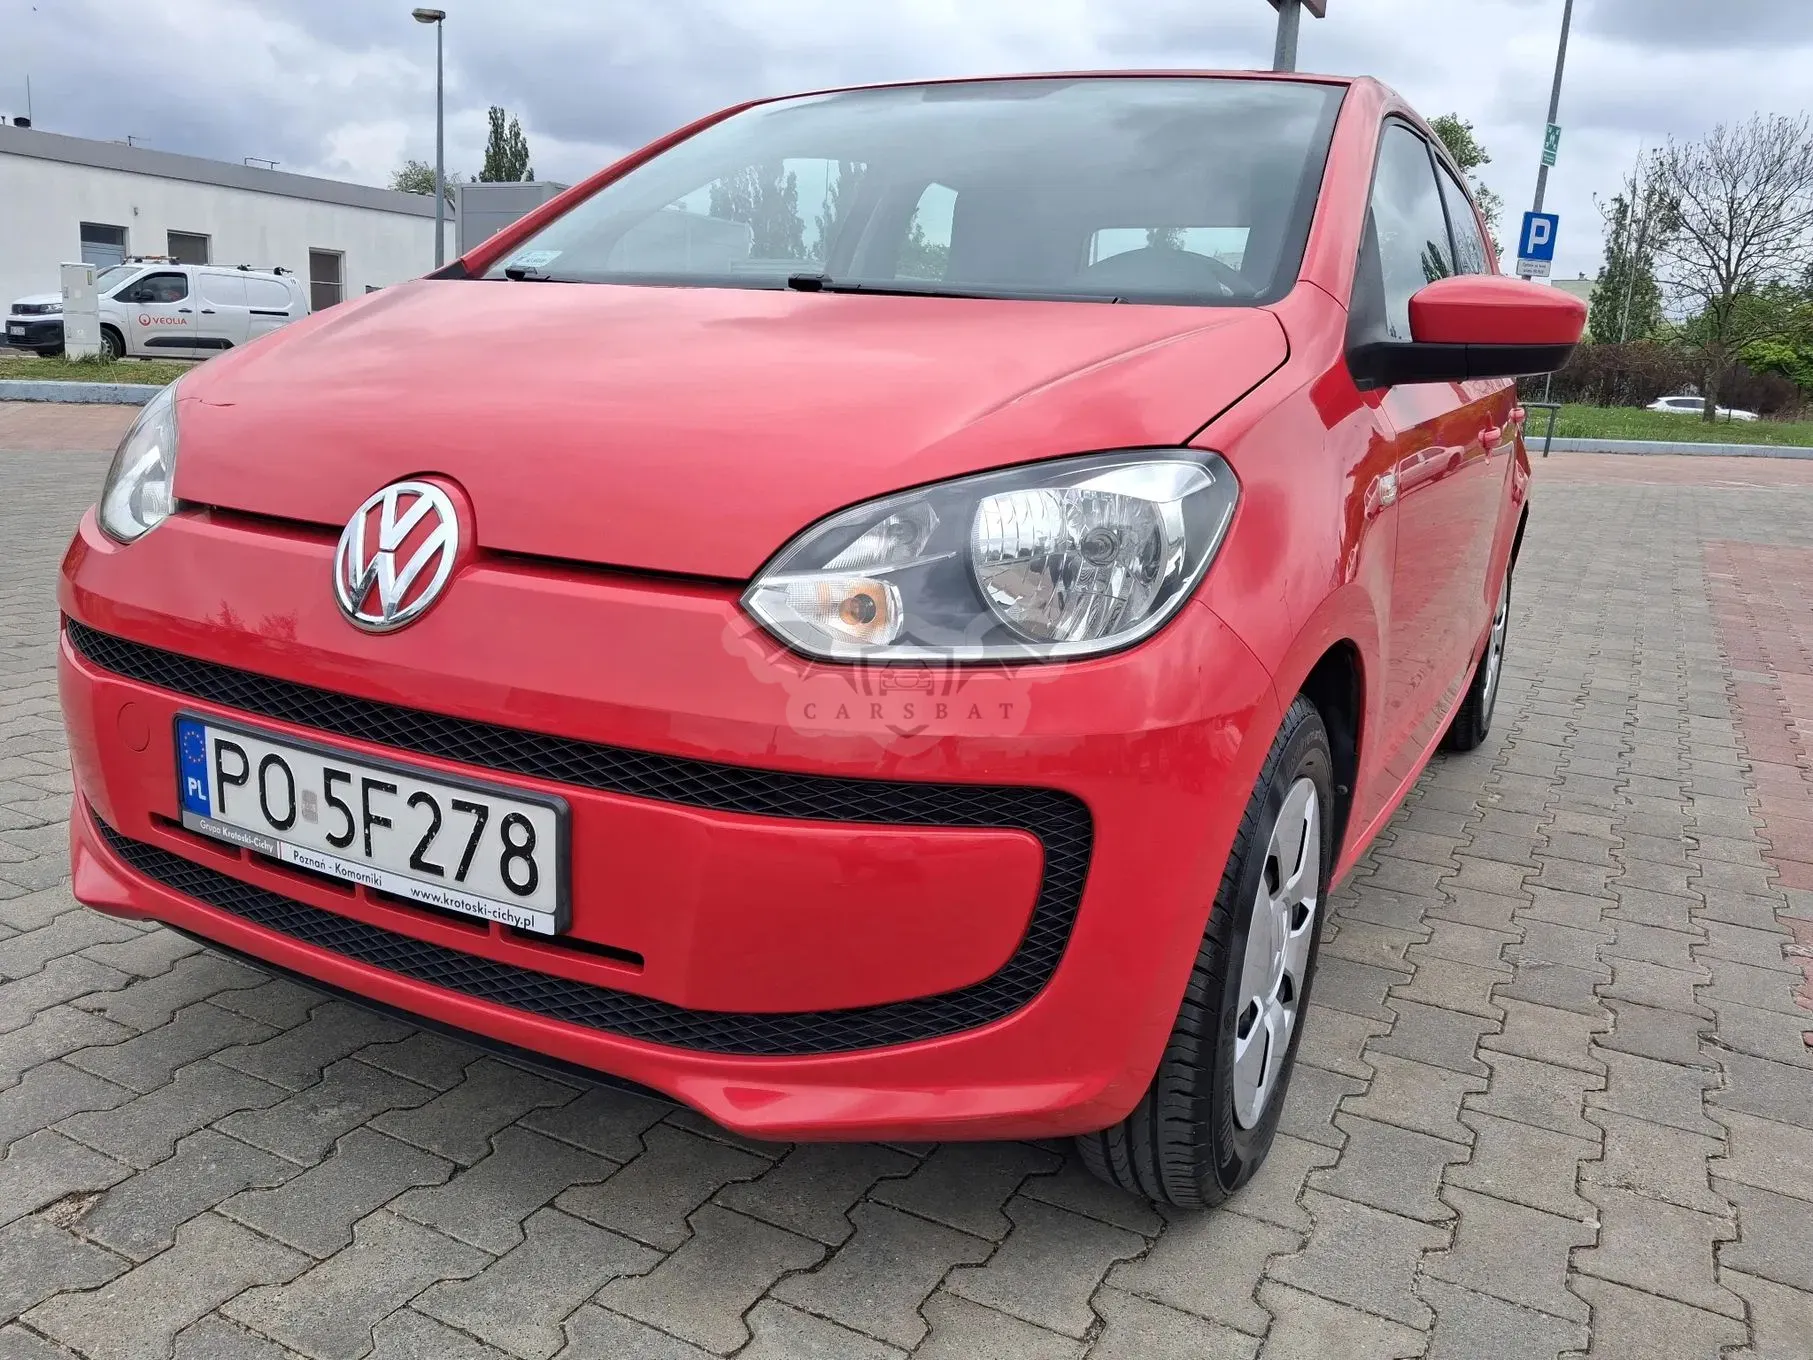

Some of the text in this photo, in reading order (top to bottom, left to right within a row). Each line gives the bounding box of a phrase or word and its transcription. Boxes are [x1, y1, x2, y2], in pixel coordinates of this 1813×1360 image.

[1526, 217, 1550, 254] P
[152, 317, 188, 325] VEOLIA
[187, 776, 207, 801] PL
[213, 738, 539, 897] PO 5F278
[222, 826, 274, 854] Krotoski-Cichy
[293, 850, 326, 870] Poznań
[335, 862, 382, 887] Komorniki
[410, 887, 535, 930] www.krotoski-cichy.pl
